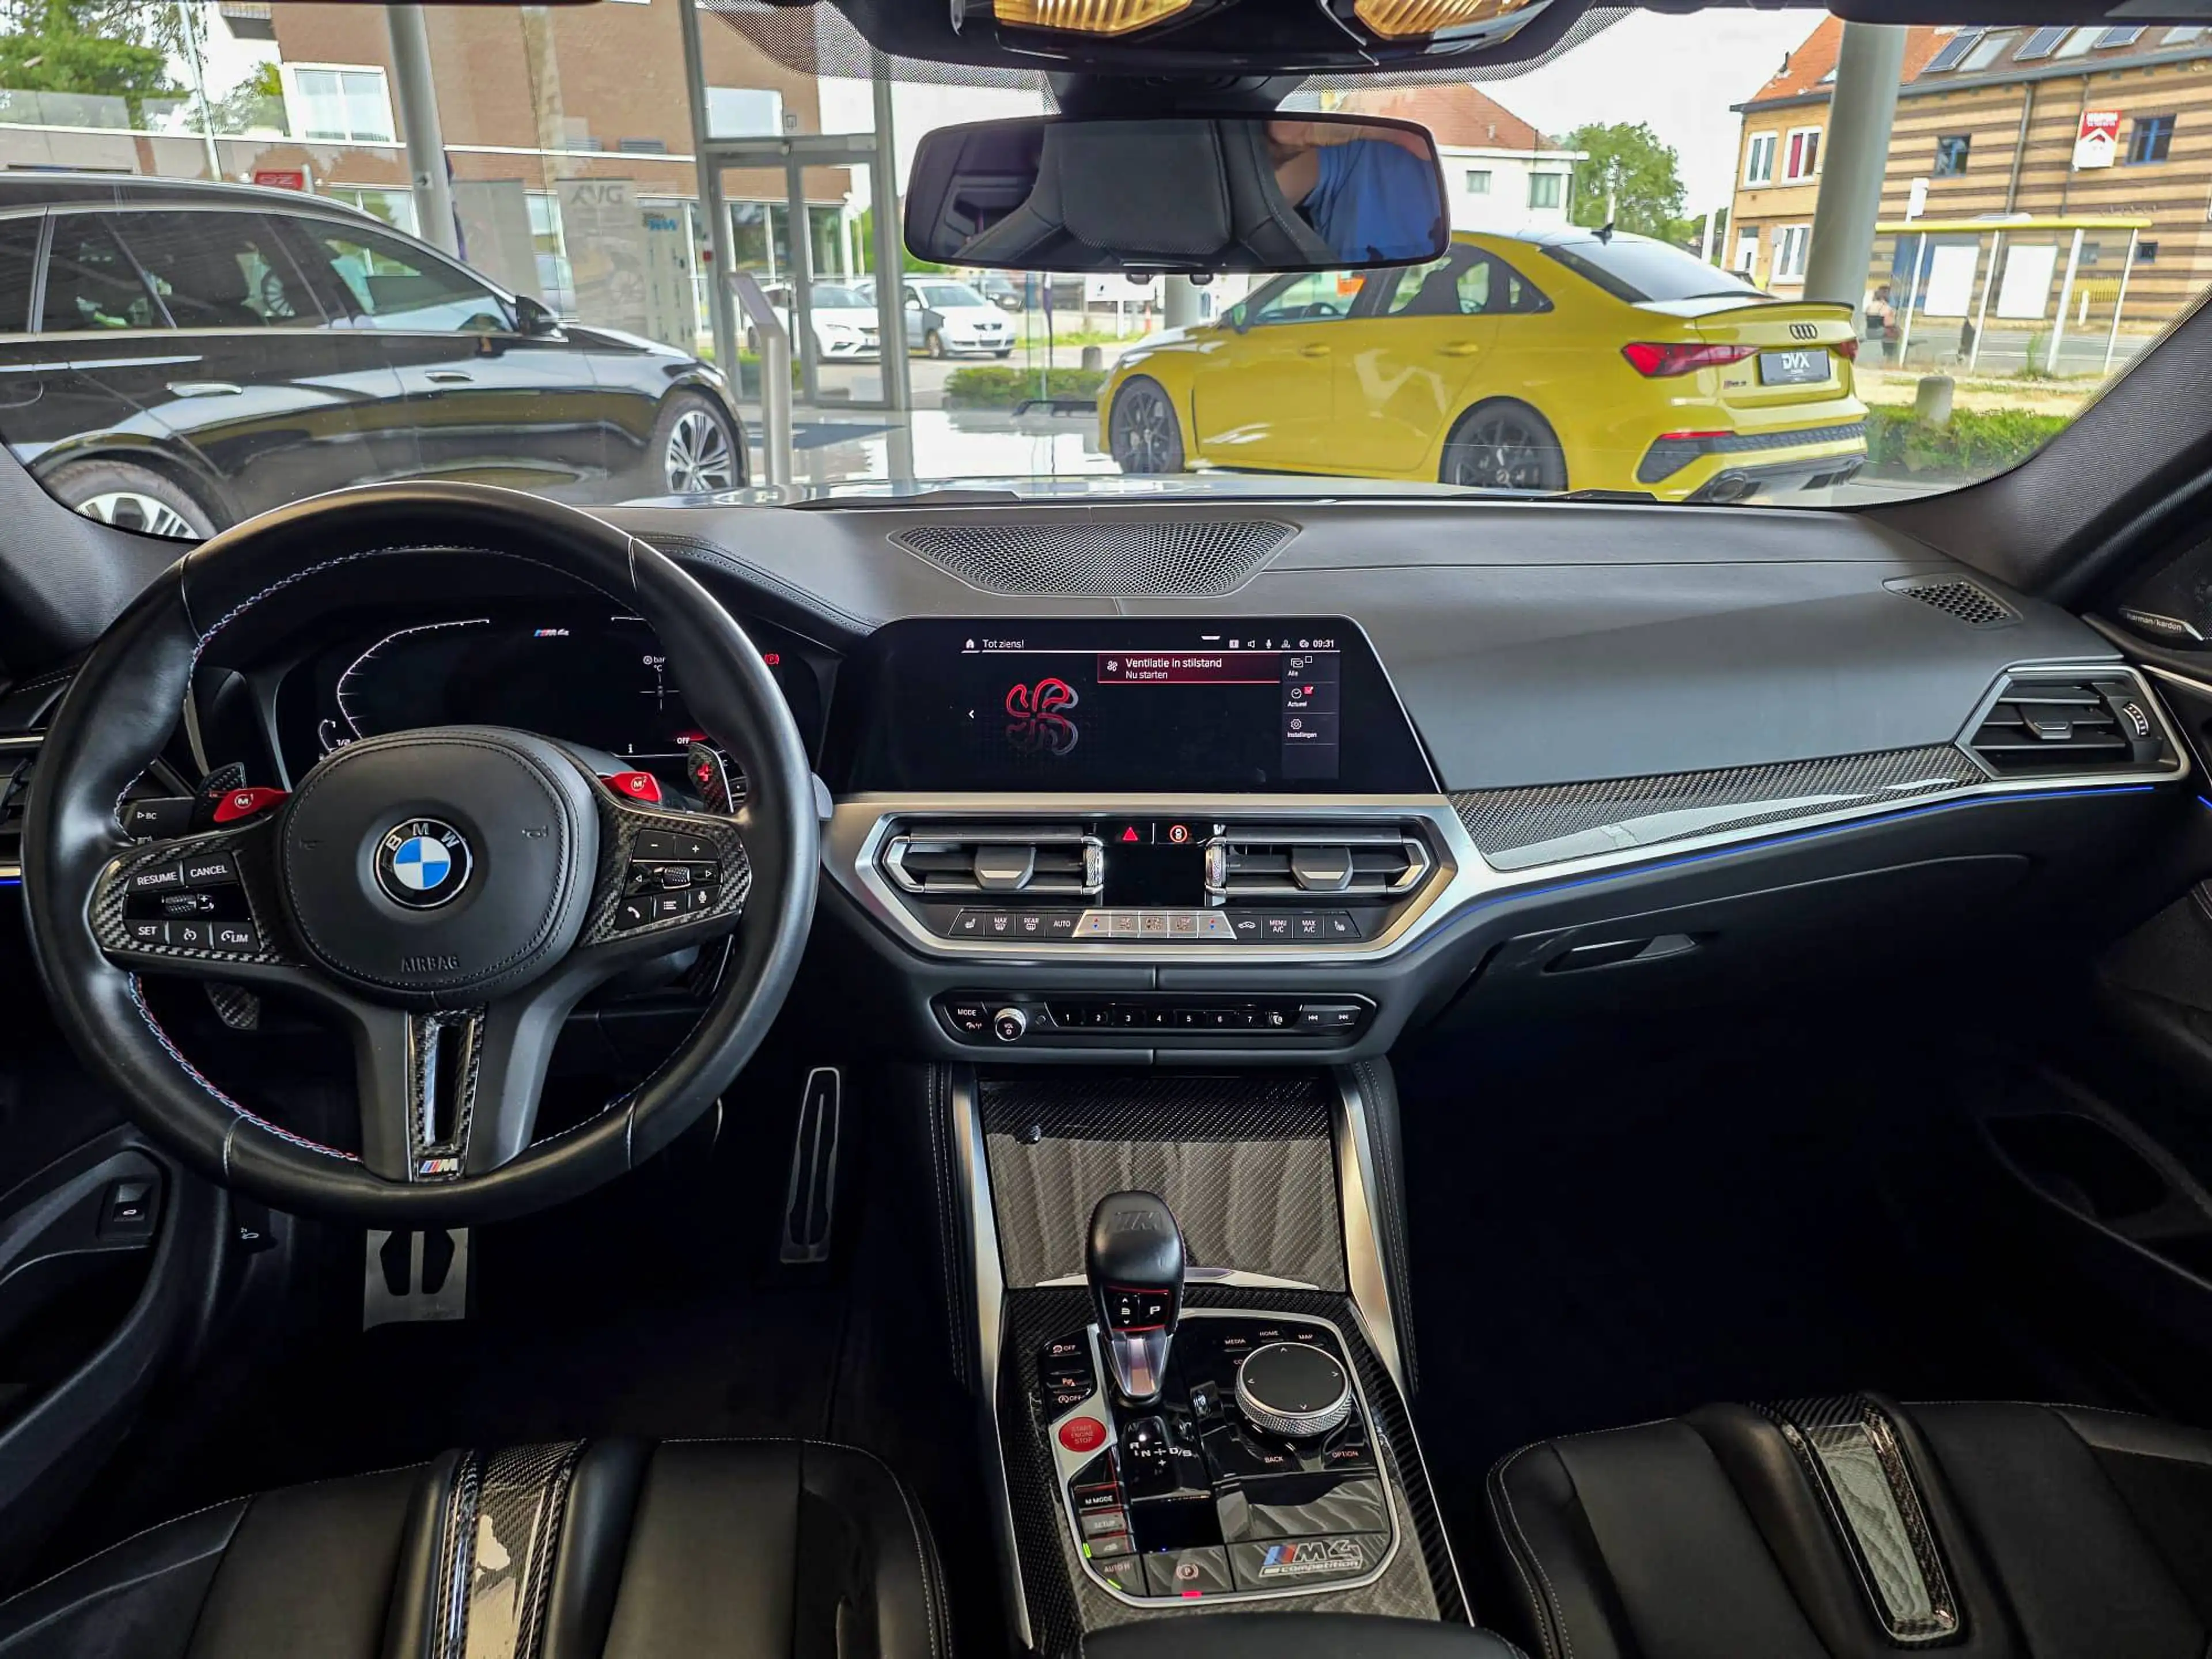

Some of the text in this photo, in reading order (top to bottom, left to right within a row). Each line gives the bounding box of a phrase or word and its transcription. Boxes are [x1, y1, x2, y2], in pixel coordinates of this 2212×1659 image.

[1781, 352, 1810, 370] DVX
[2126, 612, 2182, 631] harman/kardon
[982, 639, 1024, 649] Tot ziens!
[1312, 639, 1335, 648] 09:31
[653, 656, 665, 664] bar
[1126, 658, 1222, 668] Ventilatie in stilstand
[1126, 671, 1168, 679] Nu starten
[385, 822, 460, 851] BMW
[190, 865, 228, 877] CANCEL
[137, 872, 177, 886] RESUME
[138, 926, 157, 935] SET
[231, 933, 248, 943] LIM
[401, 956, 459, 972] AIRBAG
[1150, 1306, 1161, 1315] P
[1074, 1437, 1093, 1445] STOP
[1141, 1449, 1151, 1457] N
[1331, 1450, 1358, 1459] OPTION
[1292, 1540, 1362, 1563] M4
[1280, 1559, 1359, 1574] competition
